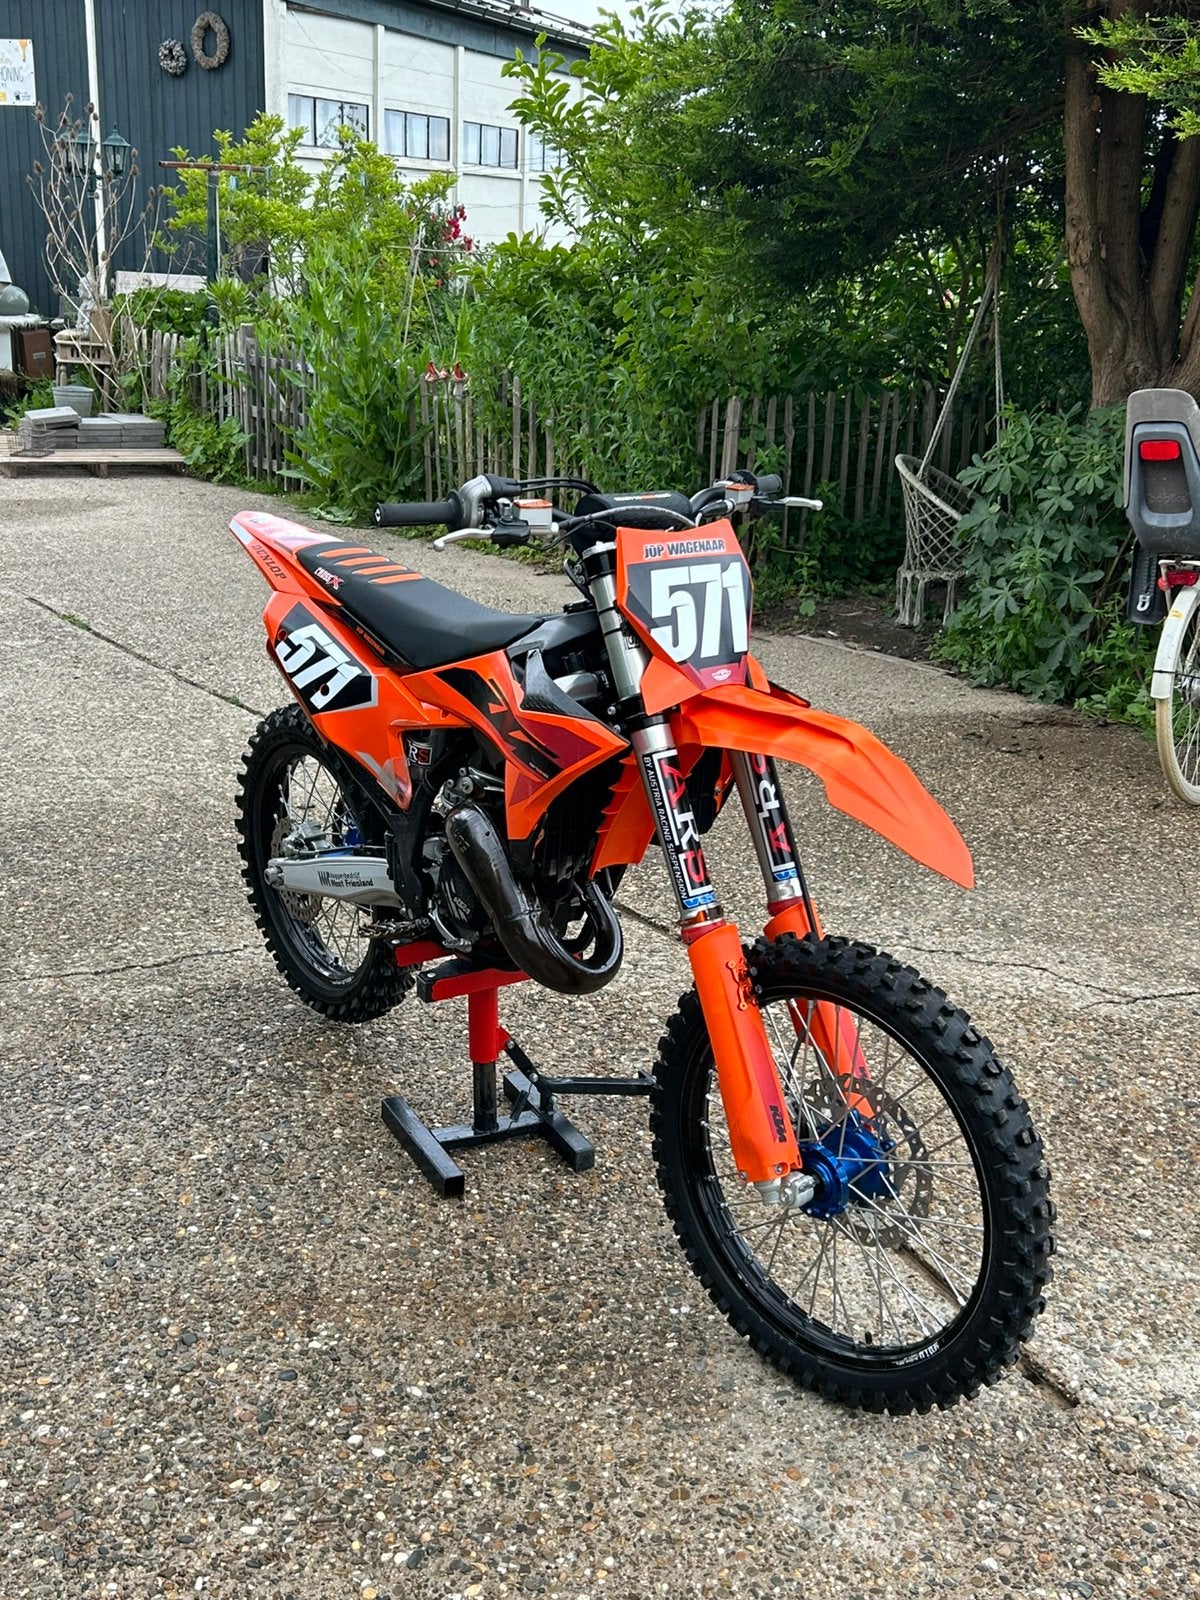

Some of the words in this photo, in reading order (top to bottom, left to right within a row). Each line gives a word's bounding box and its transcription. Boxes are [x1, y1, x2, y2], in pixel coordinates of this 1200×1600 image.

[251, 544, 286, 580] DUNLOP
[667, 539, 725, 556] WAGENAAR
[650, 561, 748, 663] 571
[276, 624, 362, 710] 571
[643, 756, 653, 767] BY
[647, 770, 662, 805] AUSTRIA
[657, 807, 673, 841] RACING
[666, 842, 688, 899] SUSPENSION
[769, 1105, 787, 1143] KTM
